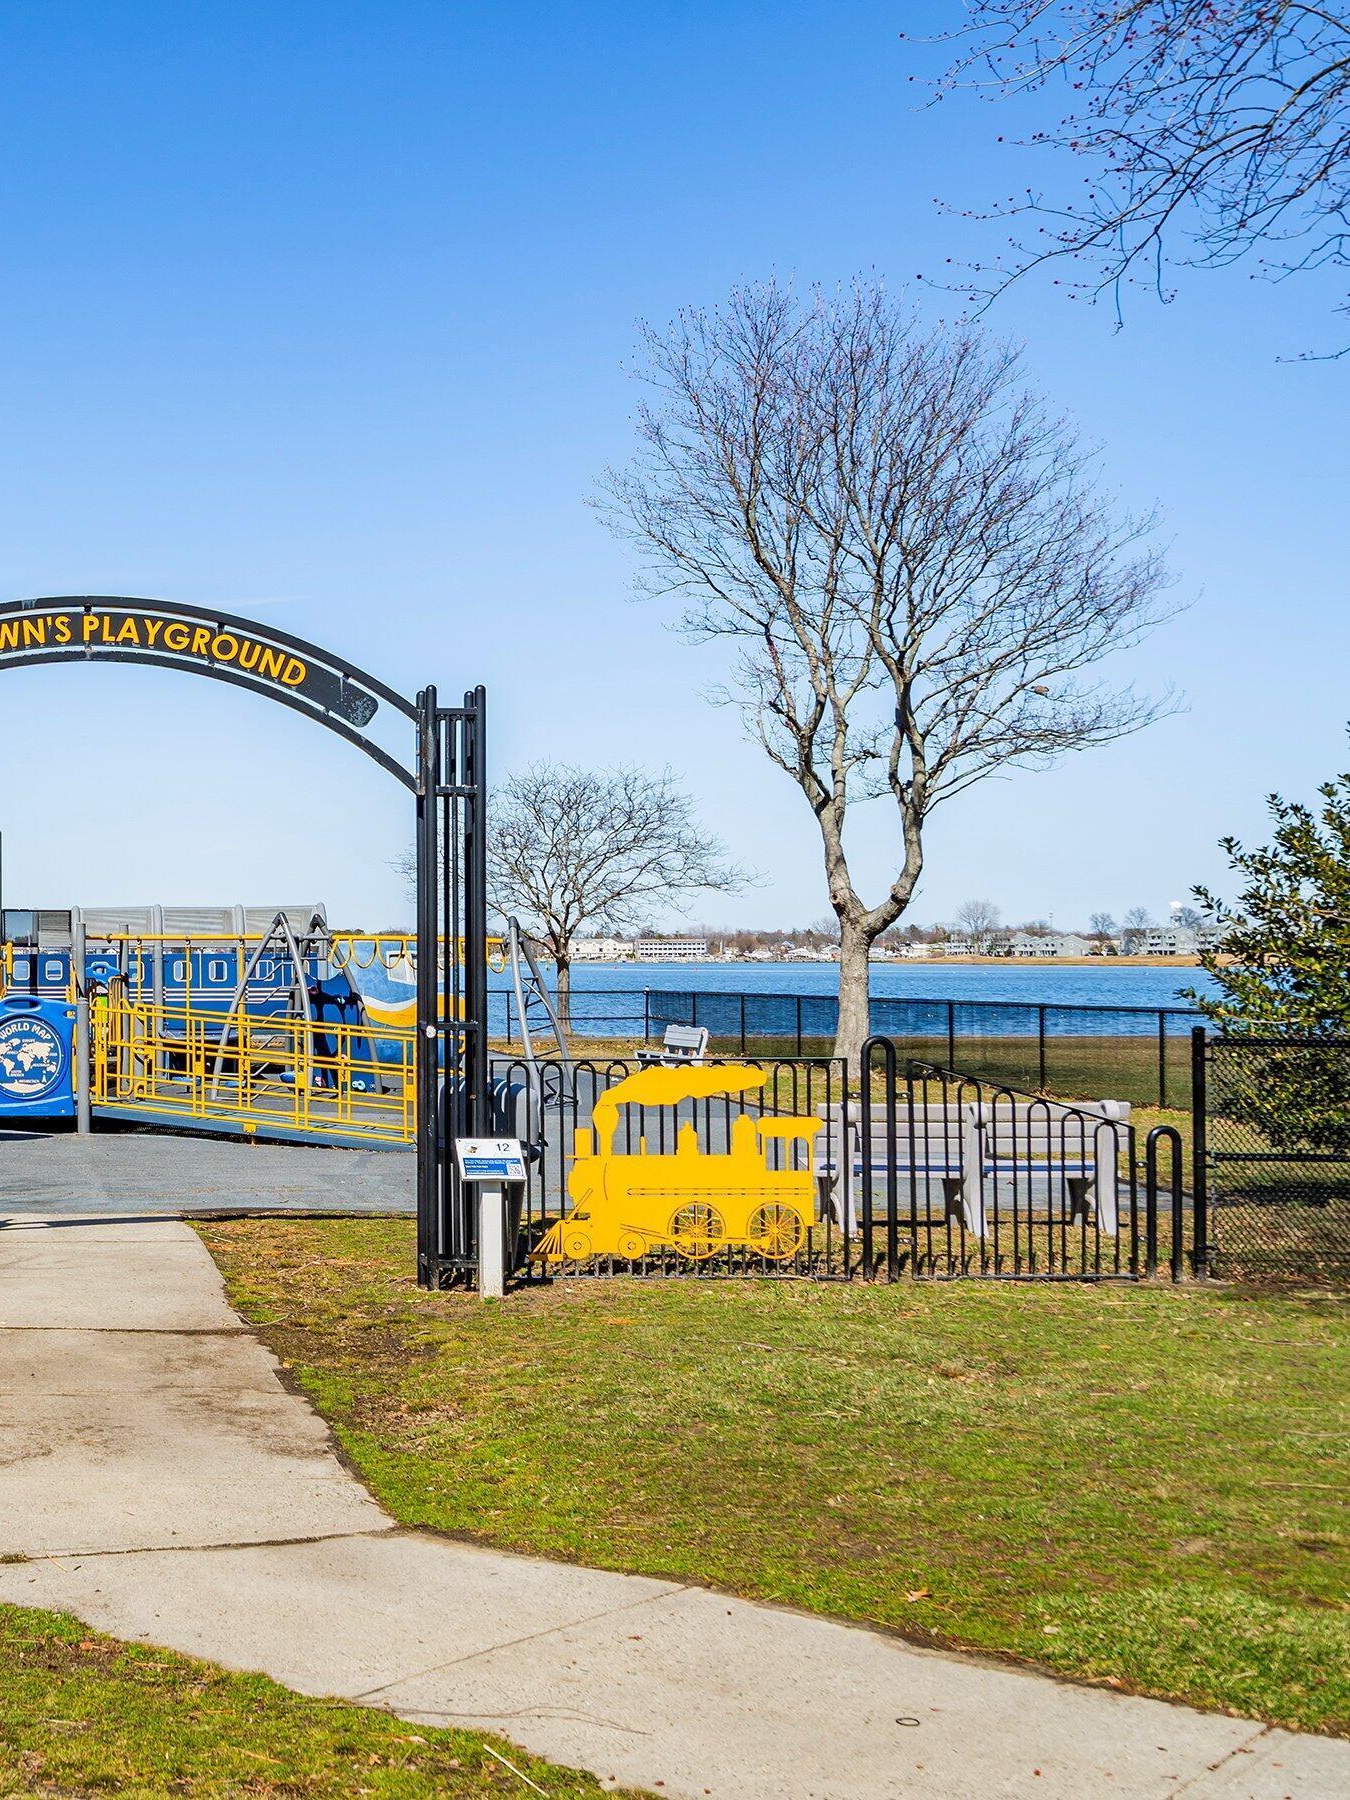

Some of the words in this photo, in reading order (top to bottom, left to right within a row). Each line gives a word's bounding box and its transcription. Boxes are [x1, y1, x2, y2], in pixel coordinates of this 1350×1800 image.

[83, 615, 308, 688] PLAYGROUND
[32, 1025, 51, 1039] MAP
[497, 1143, 510, 1151] 12
